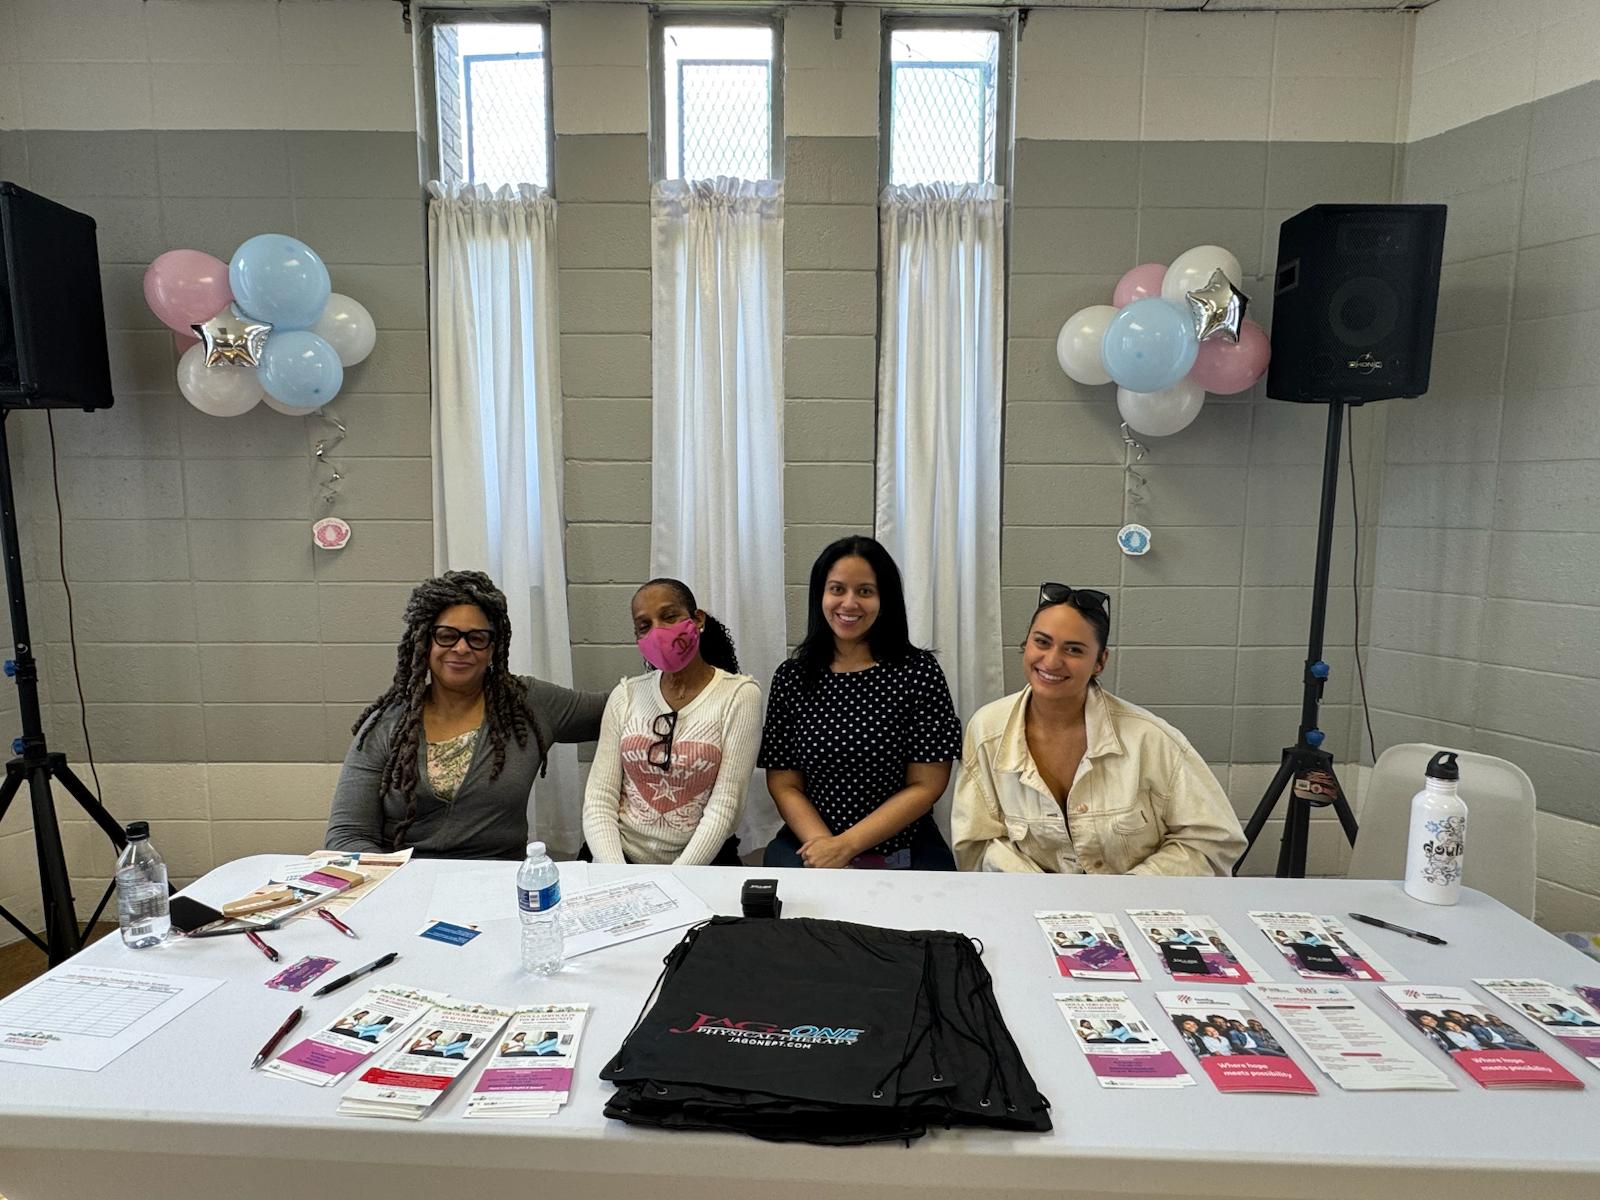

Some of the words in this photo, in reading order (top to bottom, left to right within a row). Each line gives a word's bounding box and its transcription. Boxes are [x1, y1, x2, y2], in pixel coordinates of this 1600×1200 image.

[691, 758, 716, 772] MY
[697, 1026, 777, 1040] PHYSICAL
[774, 1032, 858, 1045] THERAPY
[728, 1037, 812, 1050] JAGONEPT.COM
[1217, 1062, 1247, 1070] Where
[1247, 1063, 1268, 1071] hope
[1251, 1070, 1292, 1079] possibility
